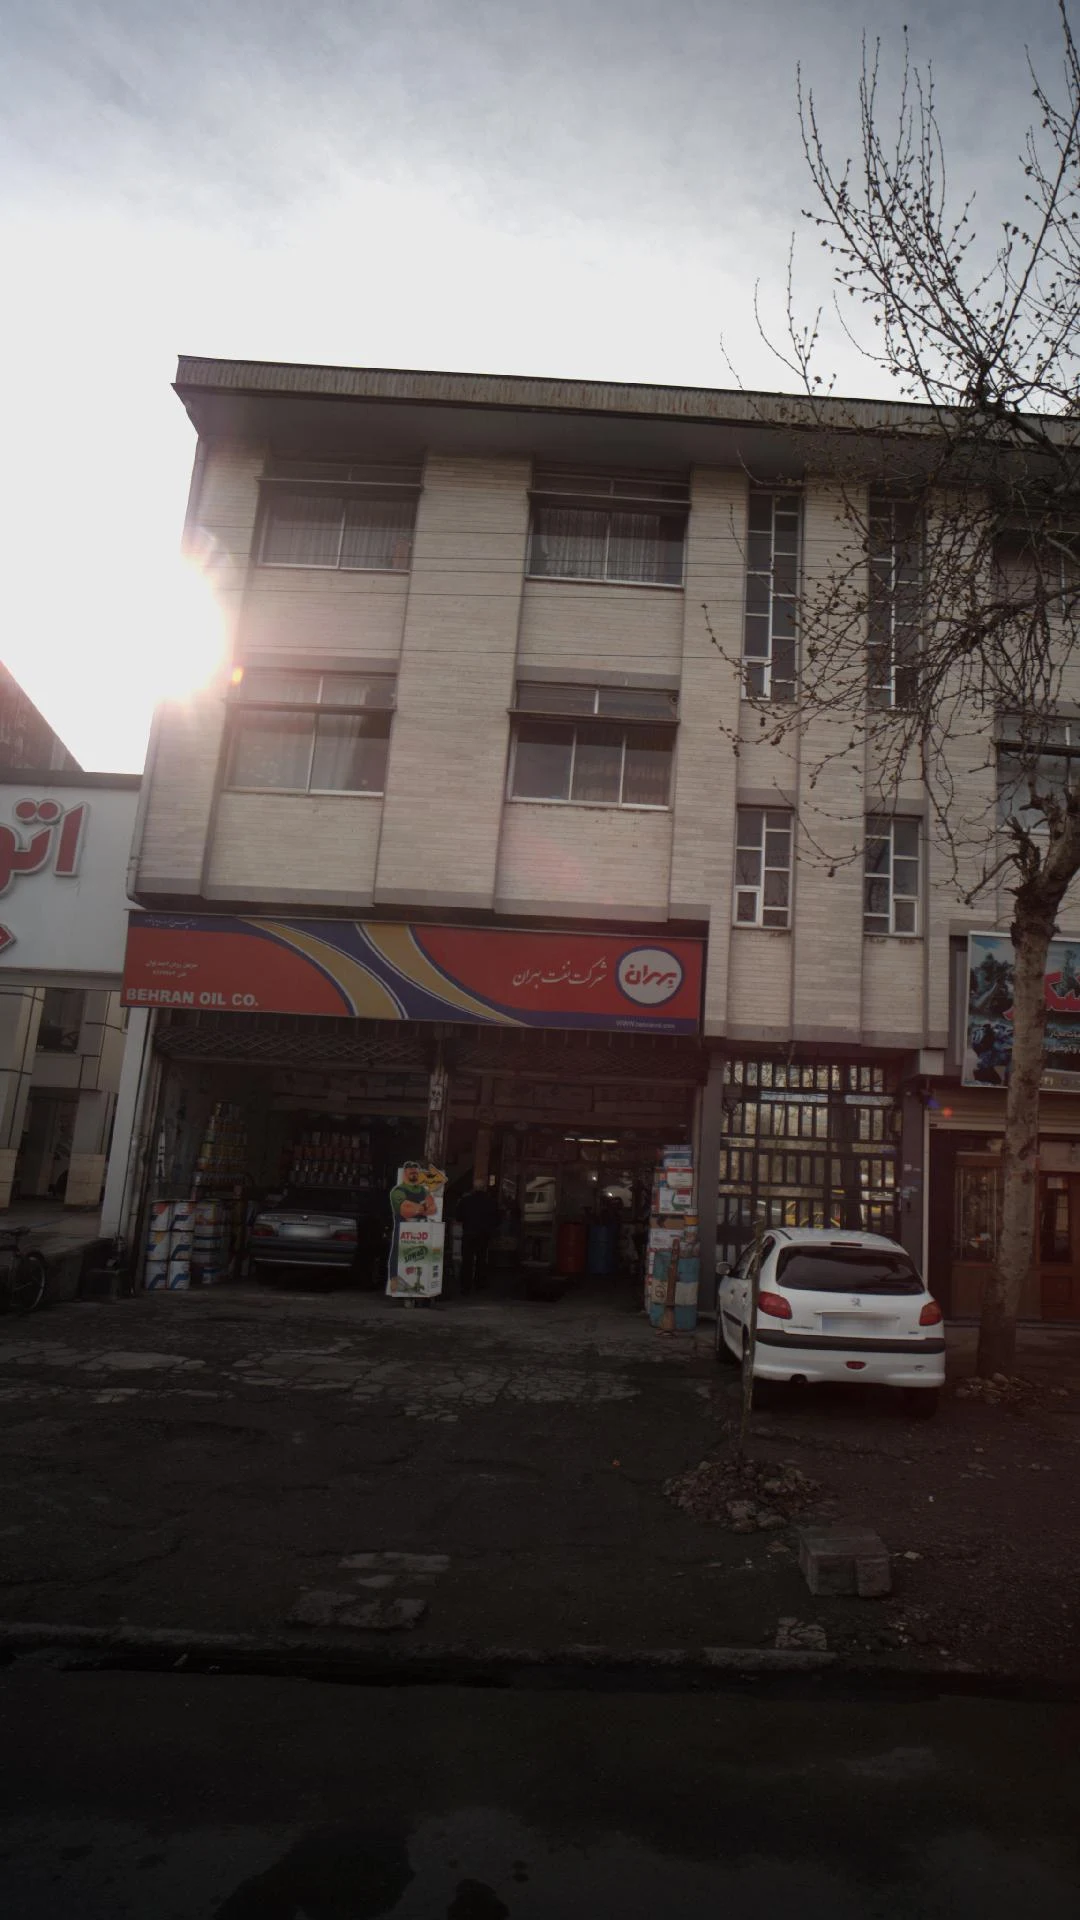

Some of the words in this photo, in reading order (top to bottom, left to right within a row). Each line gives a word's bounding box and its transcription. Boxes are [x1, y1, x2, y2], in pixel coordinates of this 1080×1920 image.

[512, 968, 541, 989] بهران
[541, 960, 571, 983] نفت
[568, 953, 608, 989] شرکت
[126, 988, 194, 1004] BEHRAN
[200, 992, 226, 1006] OIL
[232, 993, 259, 1006] CO.
